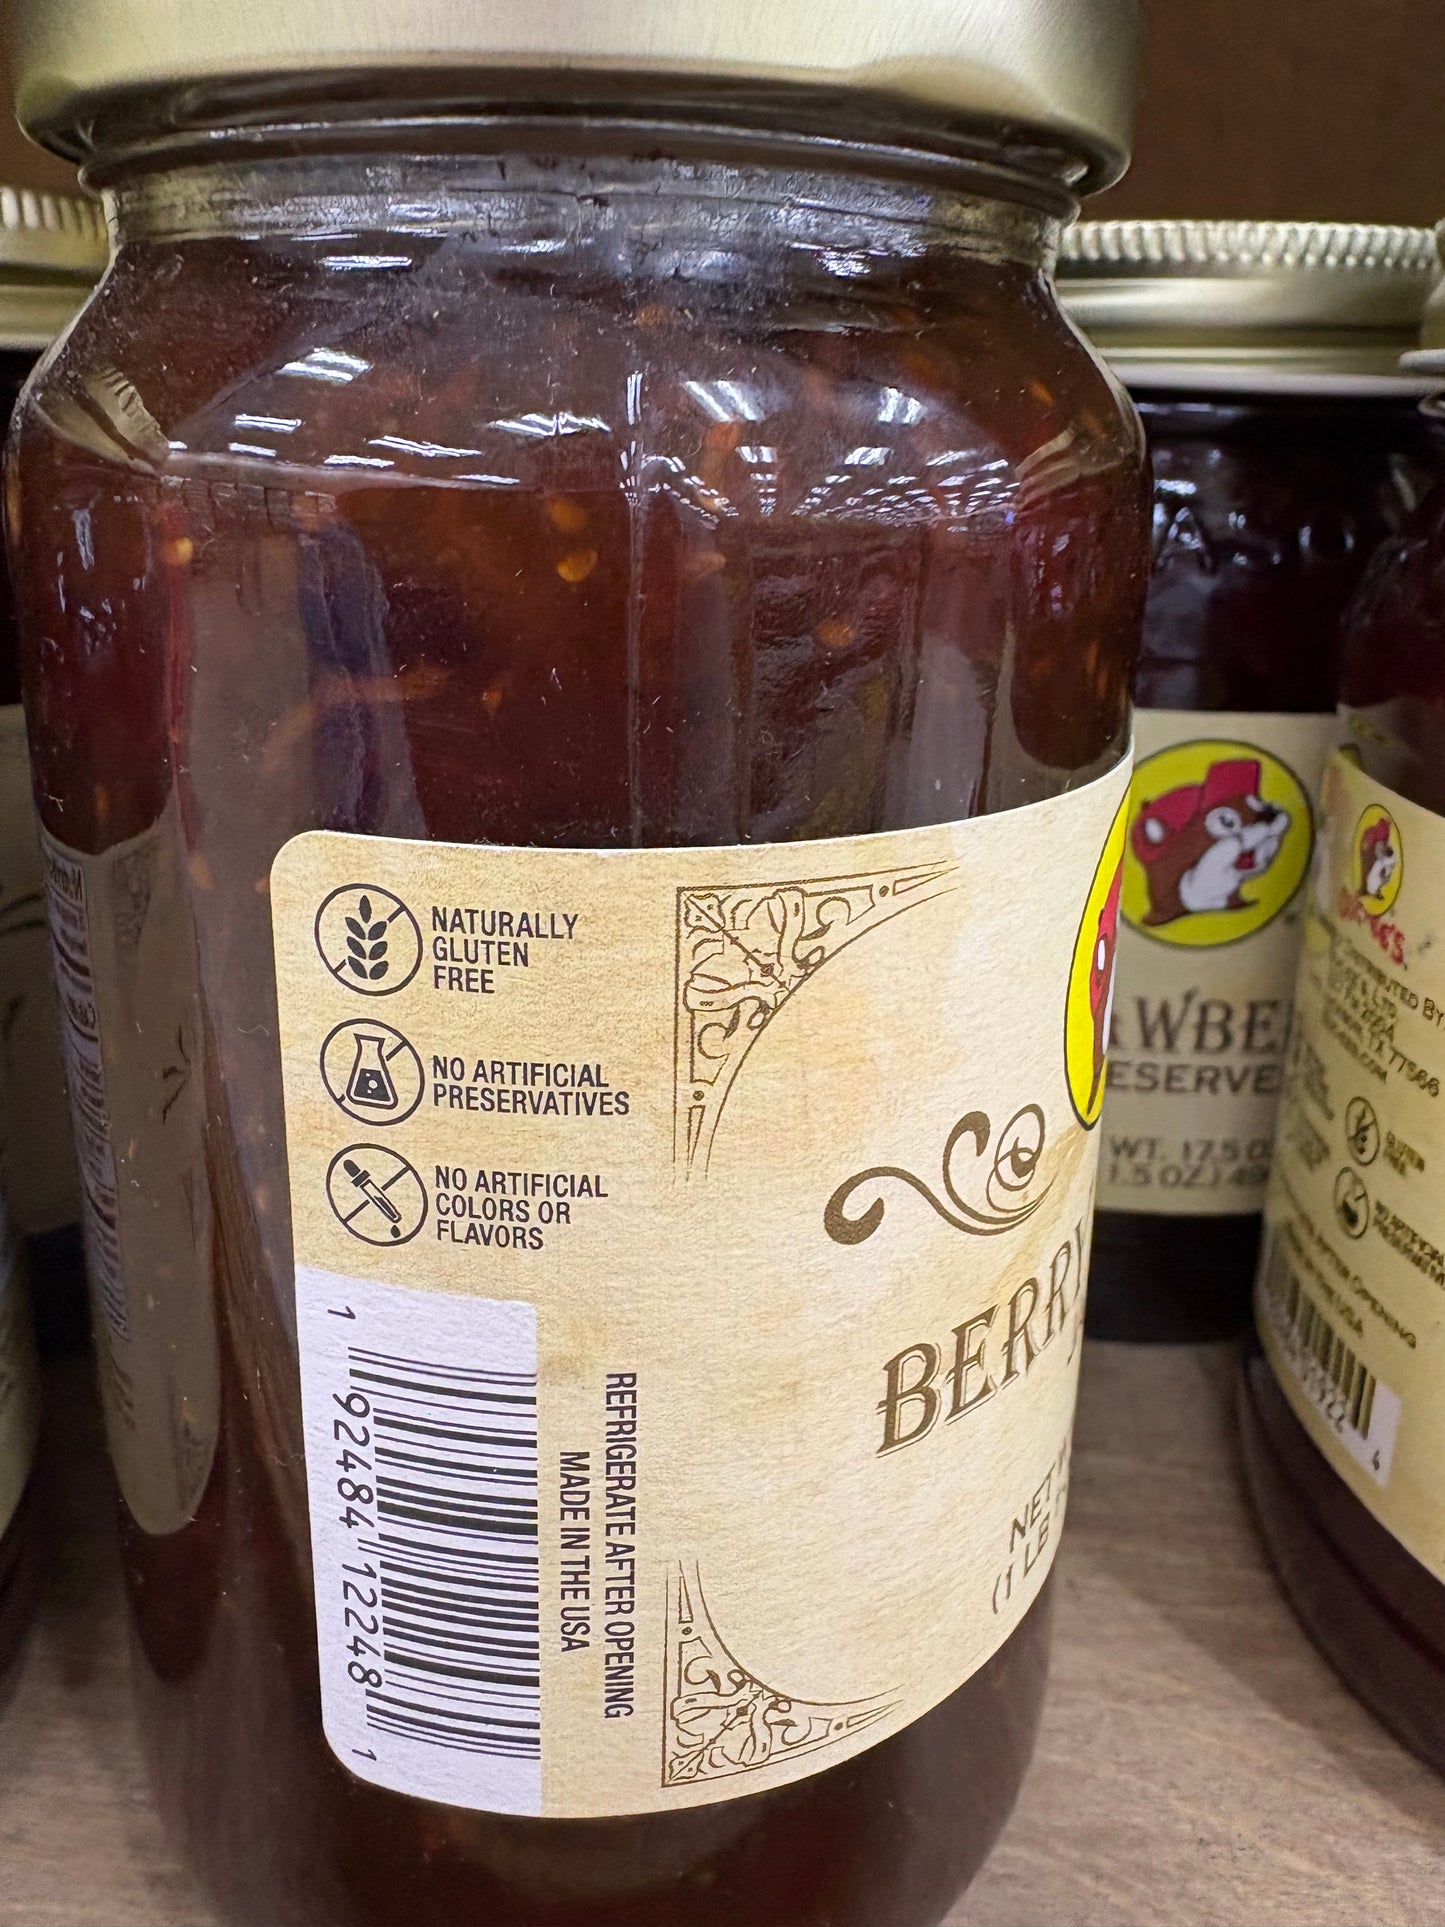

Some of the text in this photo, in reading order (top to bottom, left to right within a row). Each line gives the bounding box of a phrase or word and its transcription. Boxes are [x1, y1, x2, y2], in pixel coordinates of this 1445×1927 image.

[432, 906, 579, 940] NATURALLY
[433, 937, 529, 967] GLUTEN
[434, 965, 495, 994] FREE
[433, 1055, 609, 1088] NO ARTIFICIAL
[433, 1083, 630, 1116] PRESERVATIVES
[435, 1165, 609, 1198] NO ARTIFICIAL
[436, 1193, 571, 1224] COLORS OR
[437, 1220, 544, 1250] FLAVORS
[327, 1306, 384, 1762] 1 92484 12248 1
[604, 1372, 637, 1719] REFRIGERATE AFTER OPENING
[558, 1451, 590, 1653] MADE IN THE USA
